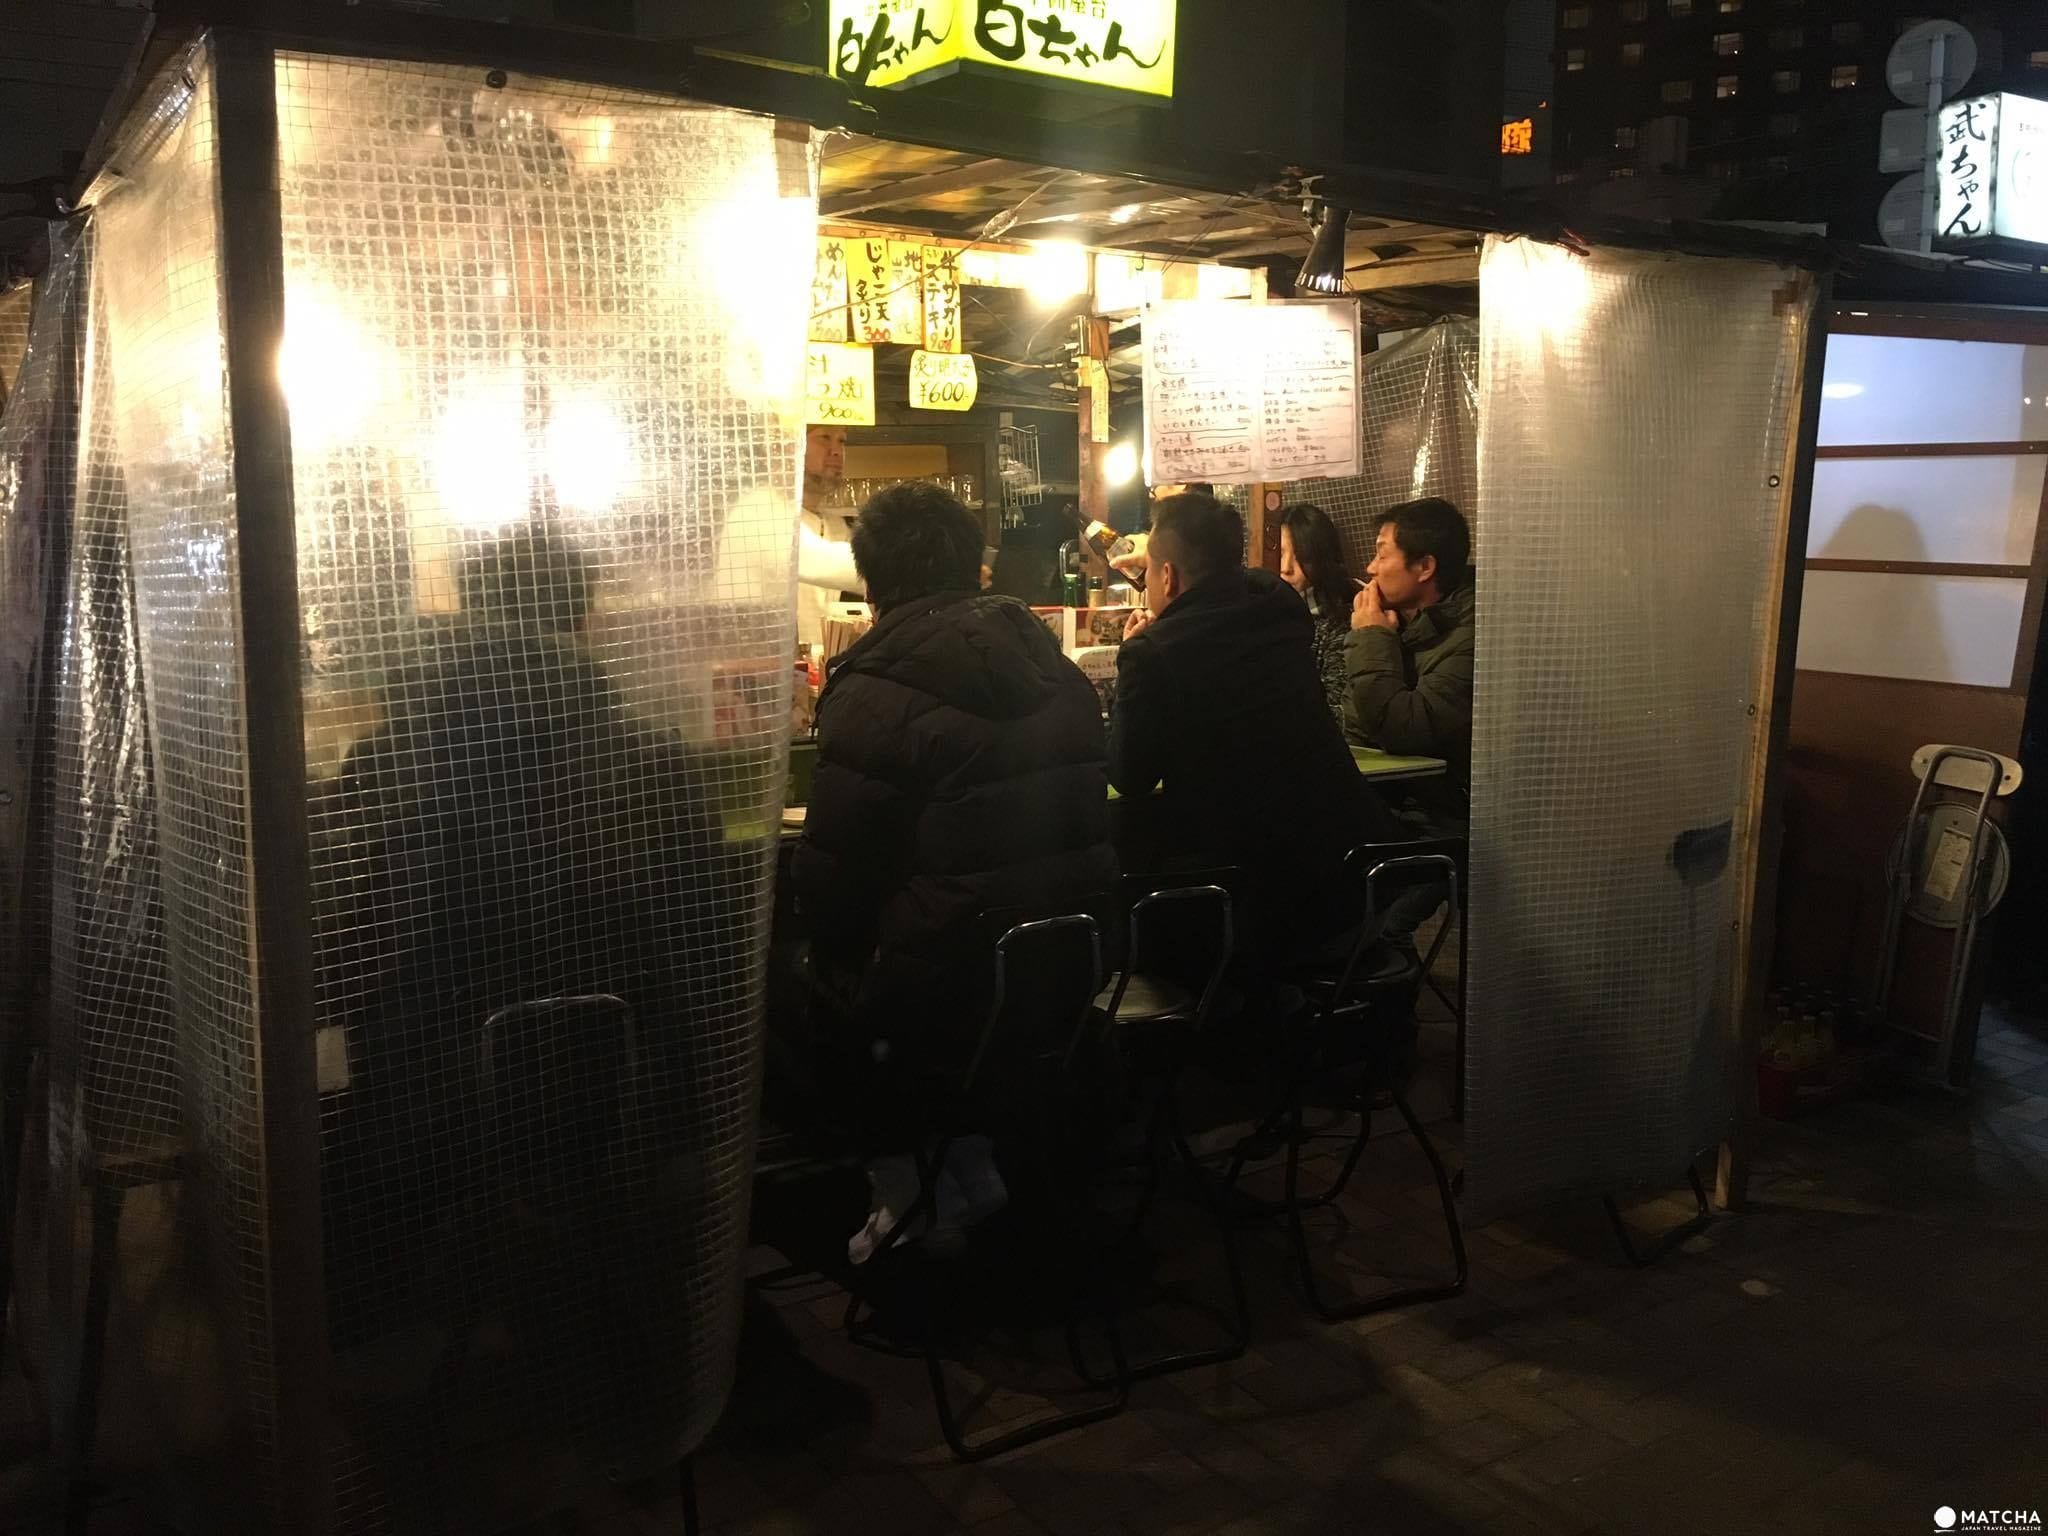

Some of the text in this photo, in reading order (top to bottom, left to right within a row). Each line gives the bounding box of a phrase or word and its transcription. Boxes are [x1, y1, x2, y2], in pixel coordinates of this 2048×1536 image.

[1944, 103, 1987, 237] 武ちゃん
[863, 325, 892, 342] 300
